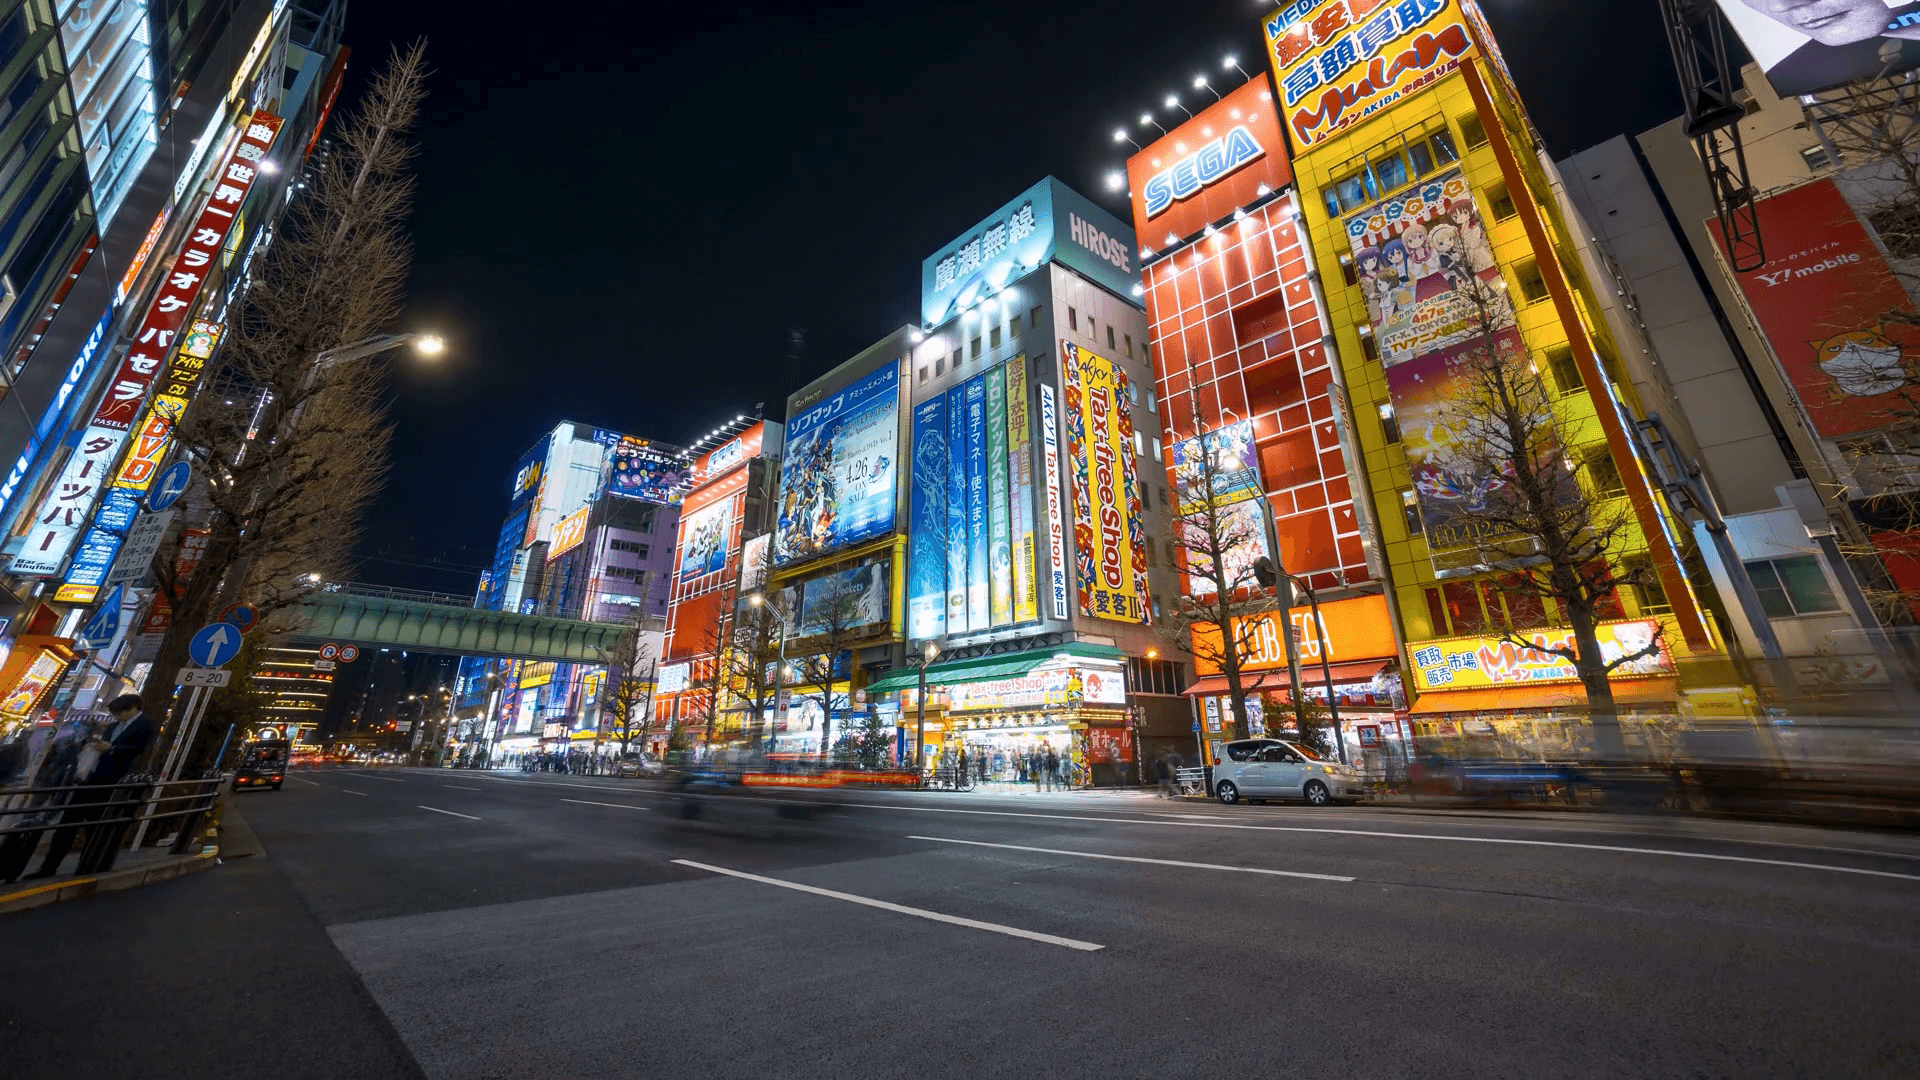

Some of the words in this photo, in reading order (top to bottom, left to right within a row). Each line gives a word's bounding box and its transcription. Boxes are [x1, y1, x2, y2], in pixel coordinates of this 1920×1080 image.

[1267, 0, 1326, 38] MED
[1282, 0, 1443, 107] 高額買取
[1291, 24, 1472, 145] Mulan
[1314, 112, 1361, 143] ムーラン
[1363, 91, 1400, 117] AKIBA
[1402, 58, 1459, 95] 中央通り店
[1144, 125, 1265, 218] SEGA
[1069, 211, 1131, 273] HIROSE
[1754, 251, 1861, 287] Y!mobile
[58, 321, 104, 410] AOKI
[171, 369, 199, 382] アニメ
[175, 355, 204, 369] アイドル
[1079, 357, 1108, 384] AKKY
[168, 384, 187, 395] CD
[795, 390, 823, 409] Sofmap
[93, 418, 130, 429] PASELA
[791, 393, 844, 435] ソフマップ
[1042, 387, 1055, 436] AKKY
[120, 416, 174, 484] DVD
[629, 449, 679, 465] ラブメルシー
[1089, 387, 1116, 505] Tax-free
[845, 457, 868, 484] 4.26
[1047, 451, 1059, 520] Tax-free
[40, 436, 118, 551] ダーツバー
[1051, 524, 1062, 567] Shop
[1100, 506, 1123, 588] Shop
[14, 563, 55, 571] Rhythm
[17, 558, 36, 566] Bar
[1235, 617, 1280, 664] CLUB
[1290, 610, 1334, 659] EGA
[343, 649, 355, 658] 50
[1414, 647, 1444, 669] 買取
[1447, 652, 1478, 671] 市場
[659, 662, 690, 692] SEGA
[1015, 678, 1043, 690] Shop
[1426, 666, 1454, 686] 販売
[1493, 669, 1531, 683] ムーラン
[1532, 667, 1563, 679] AKIBA
[1090, 729, 1131, 749] 貸ホール
